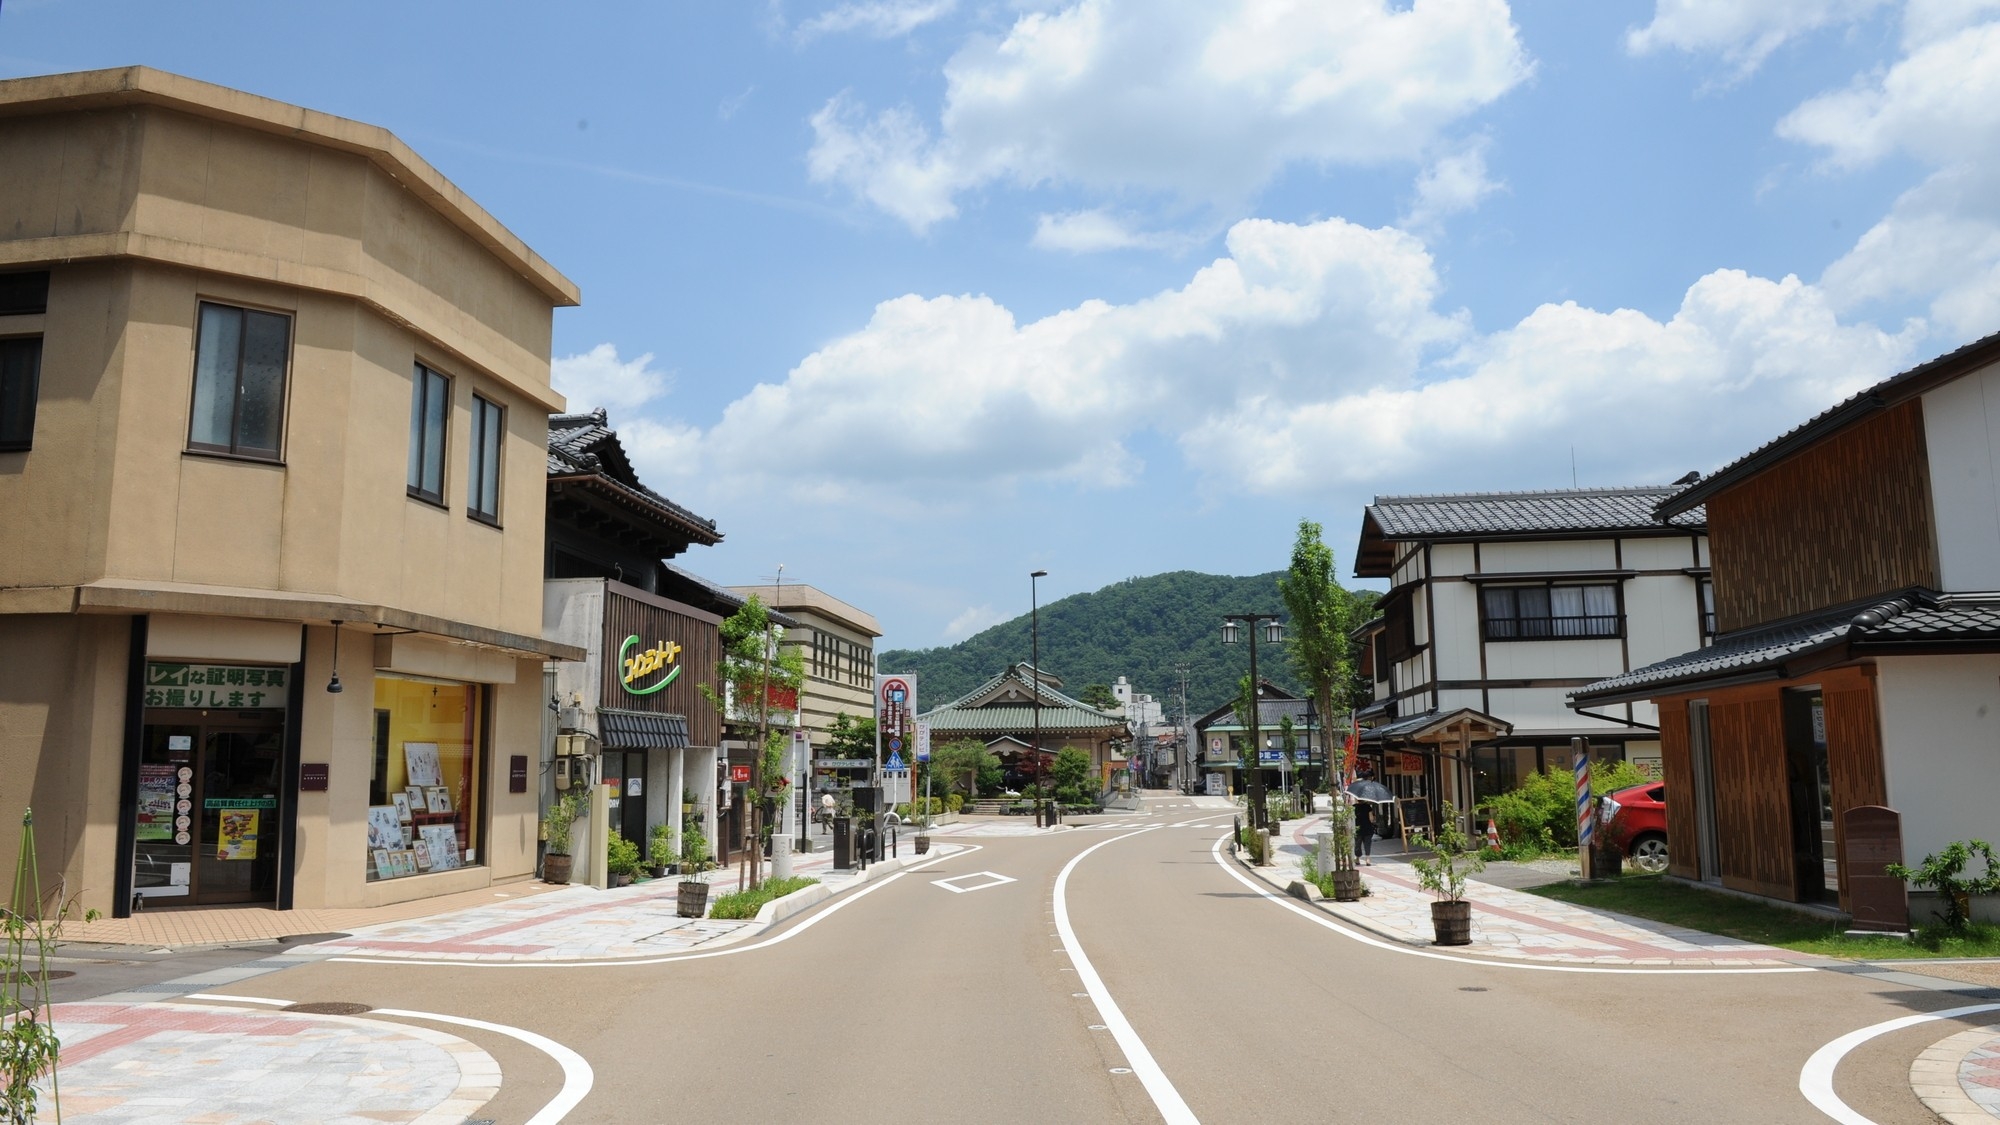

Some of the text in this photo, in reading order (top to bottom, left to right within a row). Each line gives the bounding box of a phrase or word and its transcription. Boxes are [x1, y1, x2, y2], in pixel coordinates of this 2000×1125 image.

[624, 640, 681, 684] コインランドリー
[150, 666, 285, 687] レイな証明写真
[145, 689, 266, 707] お撮りします
